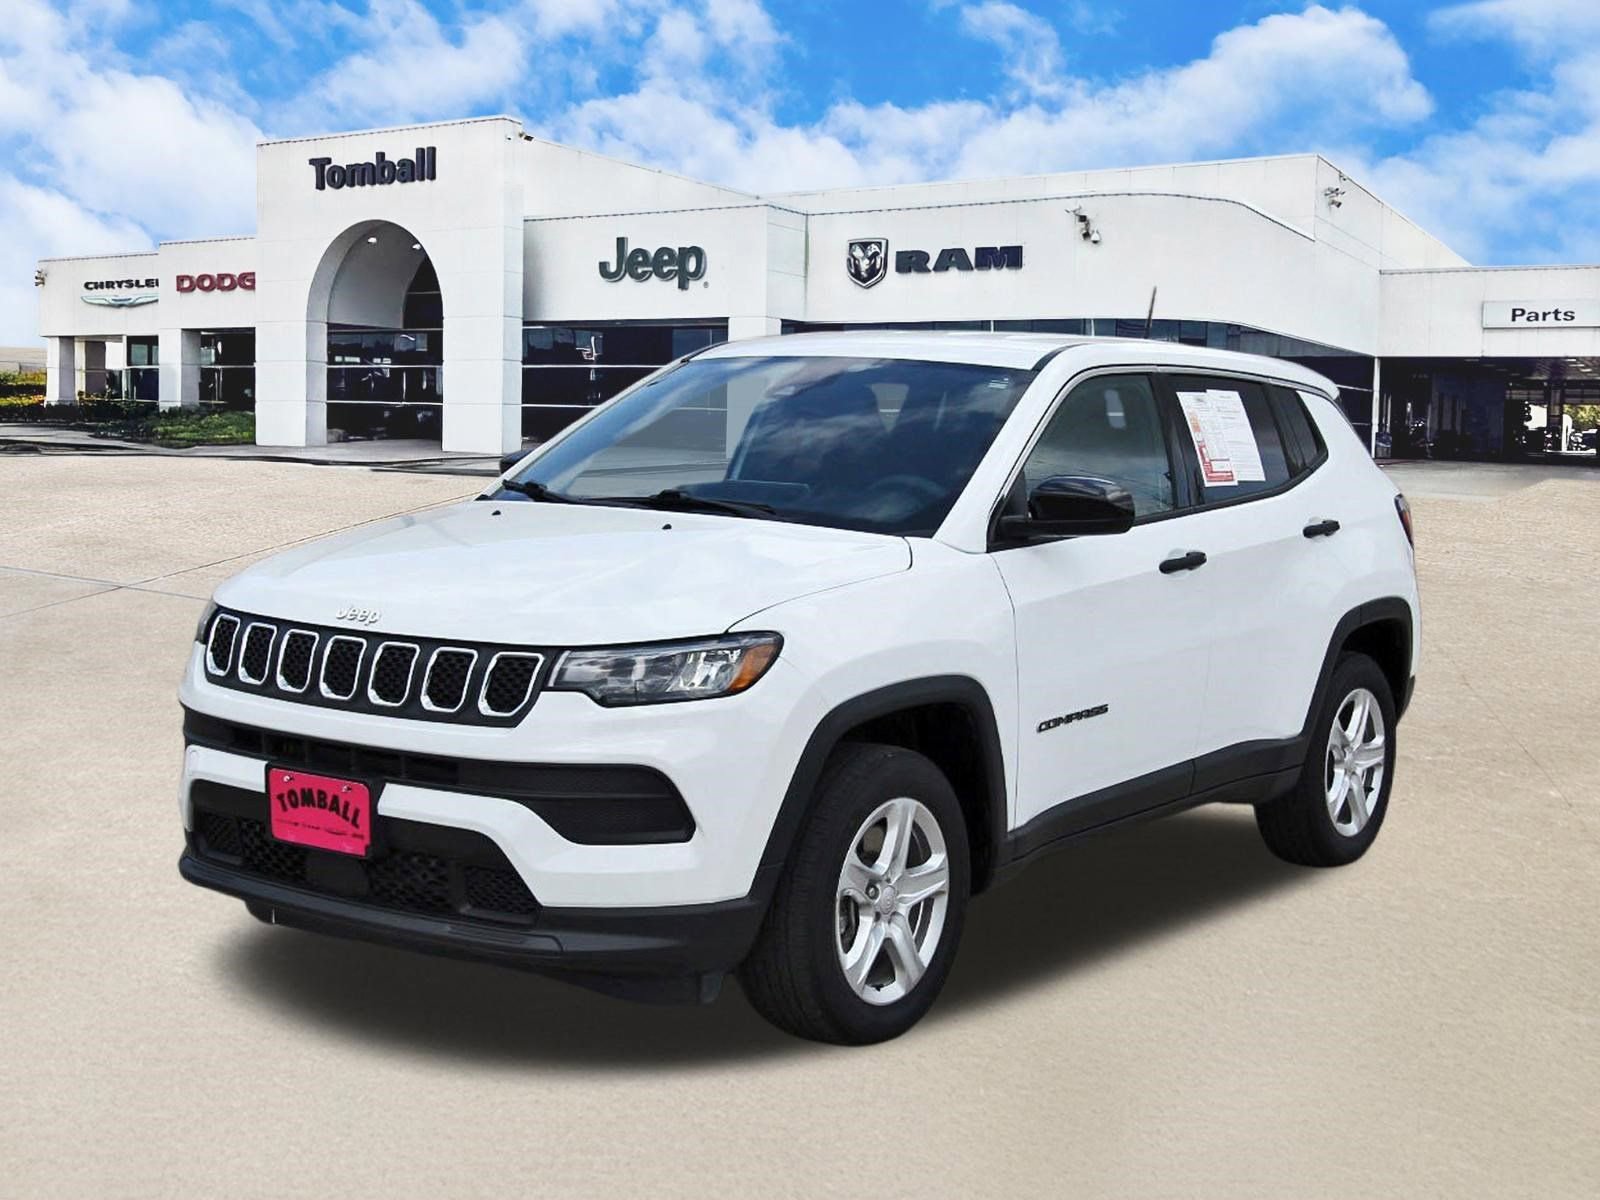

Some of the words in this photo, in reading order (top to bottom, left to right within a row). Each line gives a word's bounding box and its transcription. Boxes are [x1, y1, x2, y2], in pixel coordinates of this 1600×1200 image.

[309, 146, 436, 191] Tomball
[599, 236, 707, 291] Jeep
[895, 245, 1023, 273] RAM
[84, 278, 159, 290] CHRYSLE
[176, 272, 256, 293] DODG
[1511, 308, 1575, 322] Parts
[336, 606, 381, 626] Jeep
[1037, 703, 1109, 733] COMPASS
[276, 788, 361, 829] TOMBALL
